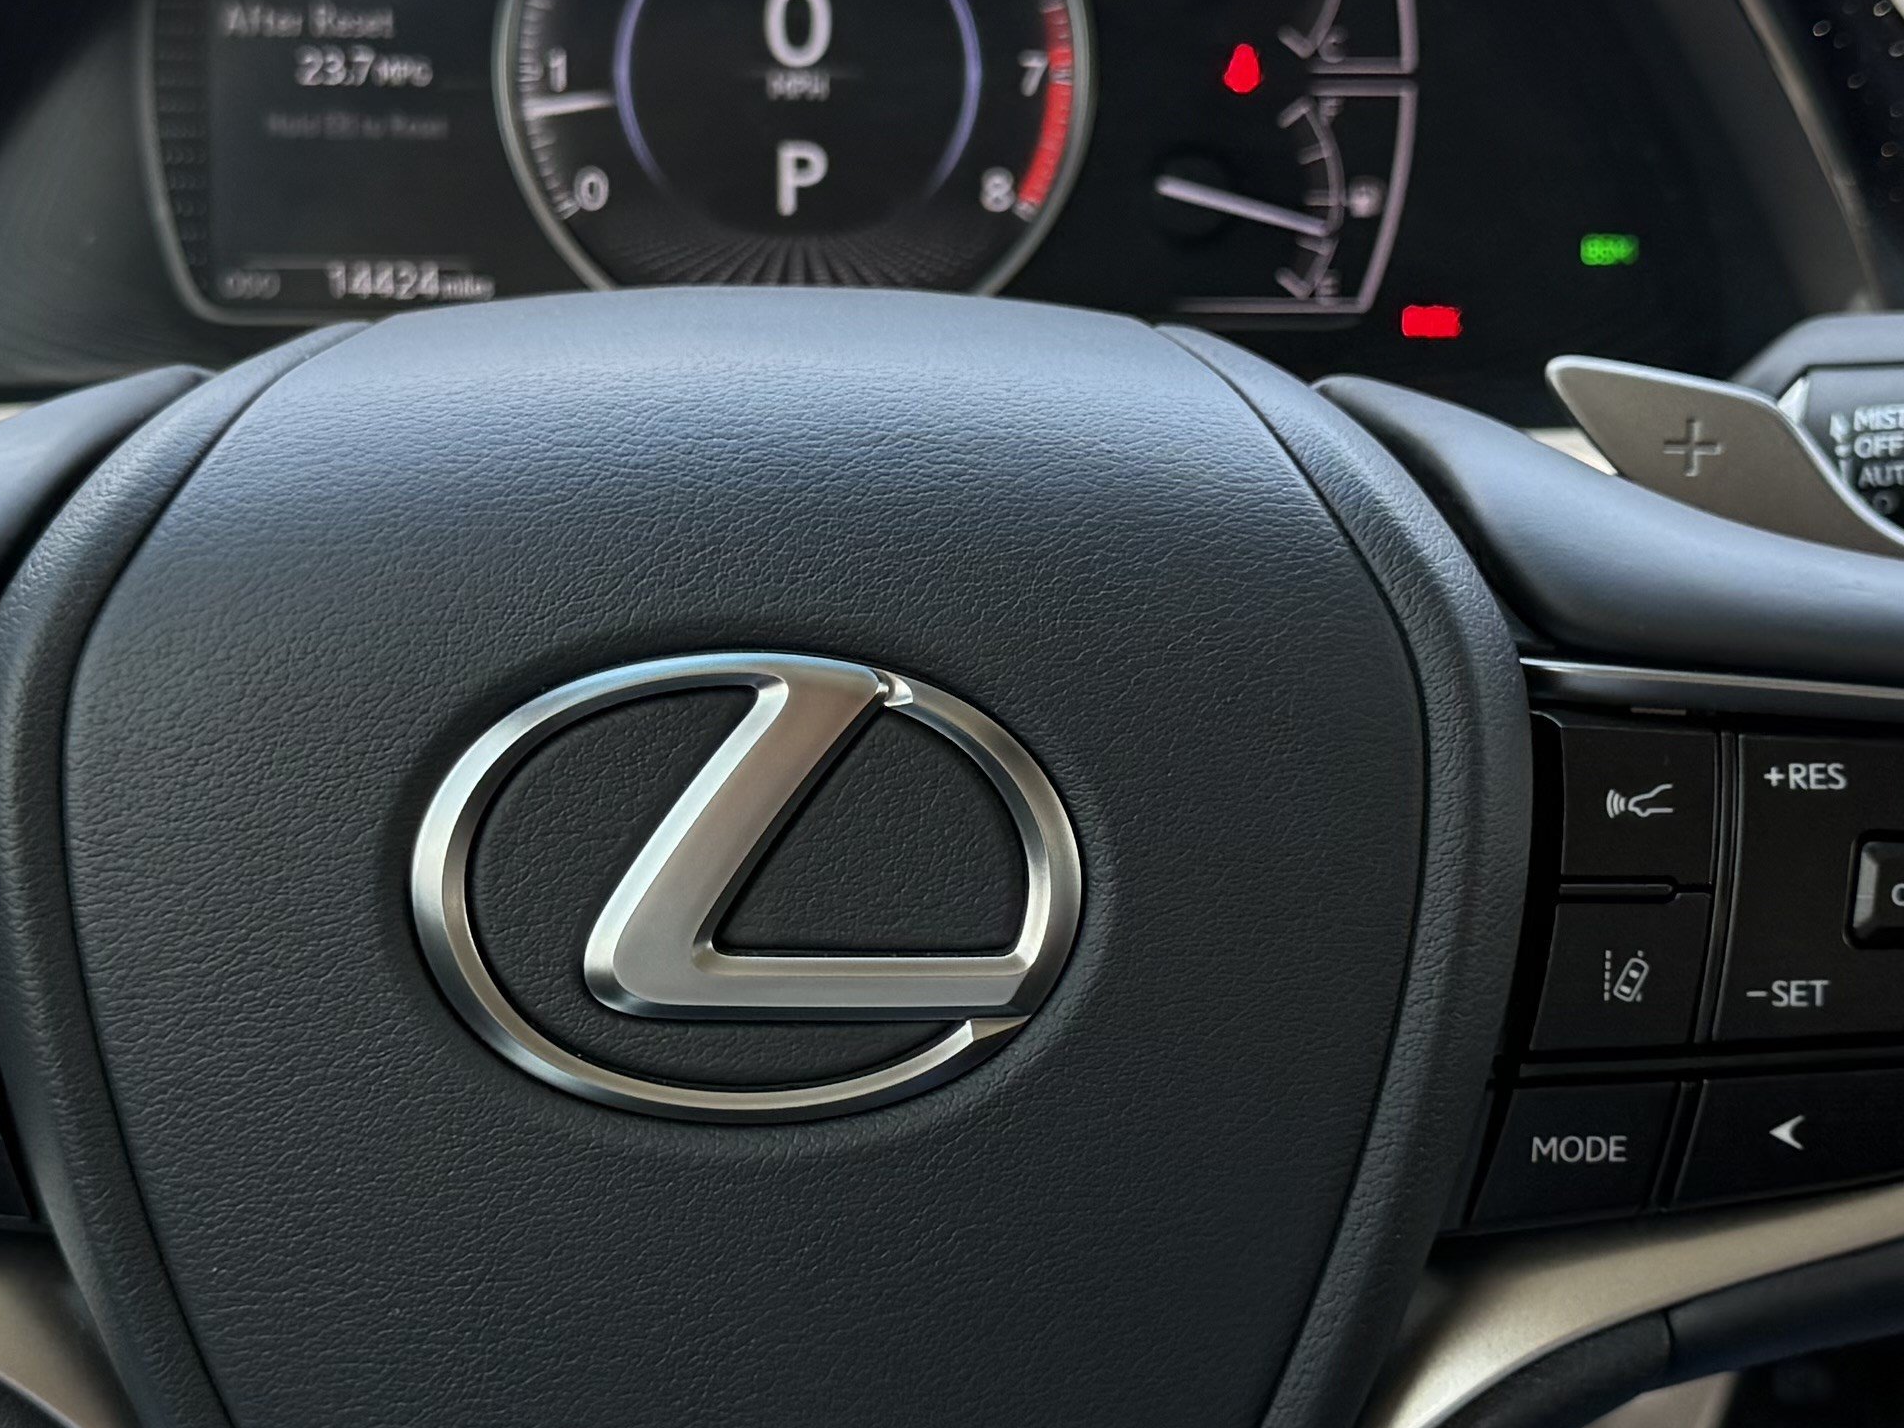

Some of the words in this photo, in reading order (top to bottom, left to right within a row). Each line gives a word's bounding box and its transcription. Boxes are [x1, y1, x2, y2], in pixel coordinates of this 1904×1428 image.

[295, 45, 377, 86] 23.7
[548, 47, 568, 93] 1
[1018, 49, 1049, 97] 7
[777, 140, 828, 217] P
[980, 165, 1016, 213] 8
[1530, 1134, 1629, 1165] MODE
